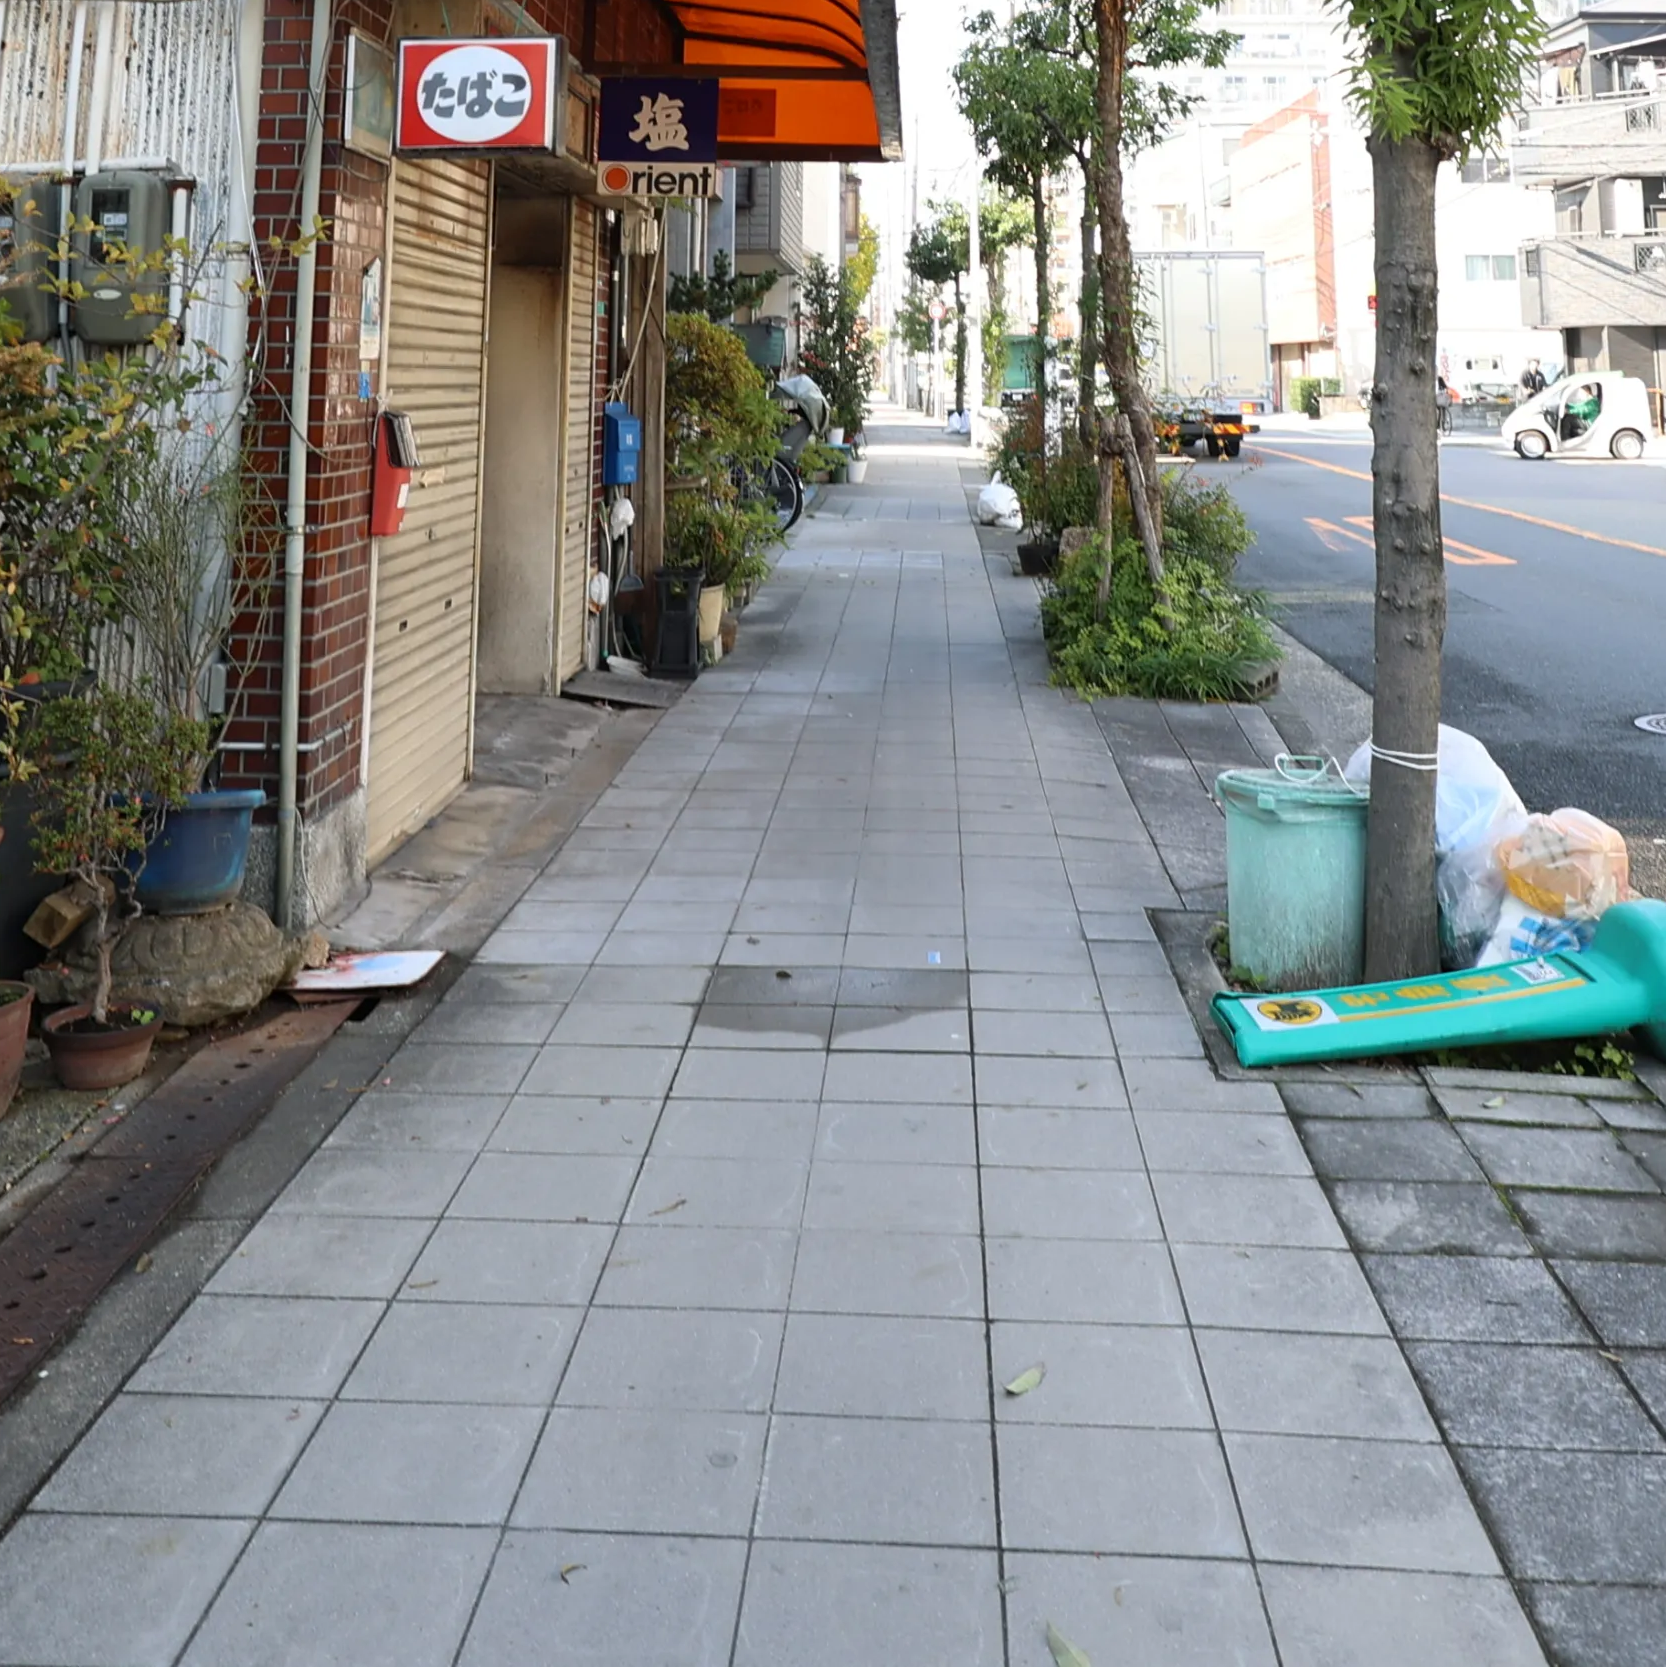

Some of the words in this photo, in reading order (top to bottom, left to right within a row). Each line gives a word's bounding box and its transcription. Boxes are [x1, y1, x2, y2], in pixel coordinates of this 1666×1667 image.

[421, 68, 527, 119] たばこ
[628, 92, 690, 152] 塩
[602, 163, 712, 195] Orient
